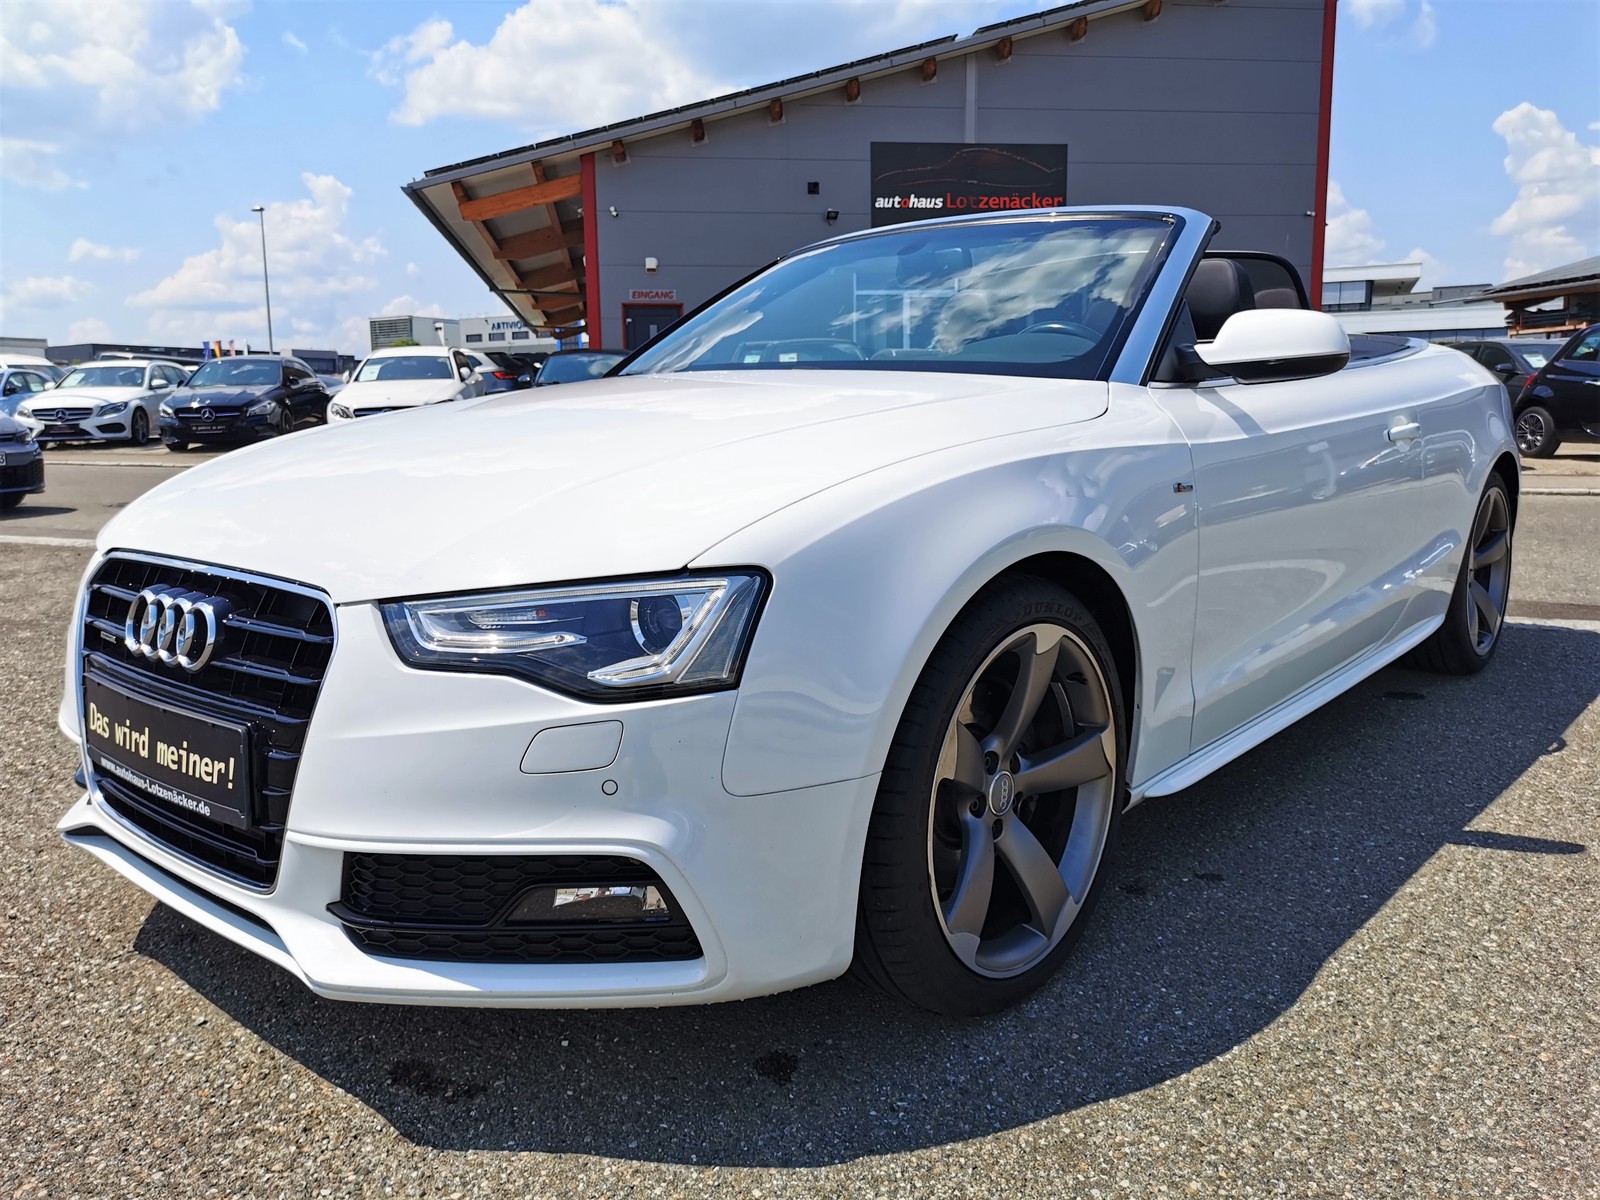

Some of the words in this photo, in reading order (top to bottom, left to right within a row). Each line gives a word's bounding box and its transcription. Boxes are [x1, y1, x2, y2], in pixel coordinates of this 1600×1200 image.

[874, 193, 943, 209] autohaus
[946, 192, 1064, 209] Lotzenäcker
[632, 291, 674, 299] EINGANG
[1021, 602, 1082, 622] DUNLOP
[88, 702, 110, 739] Das
[115, 719, 149, 758] wird
[156, 740, 236, 790] meiner!
[100, 757, 211, 816] www.autohaus-Lotzenäcker.de
